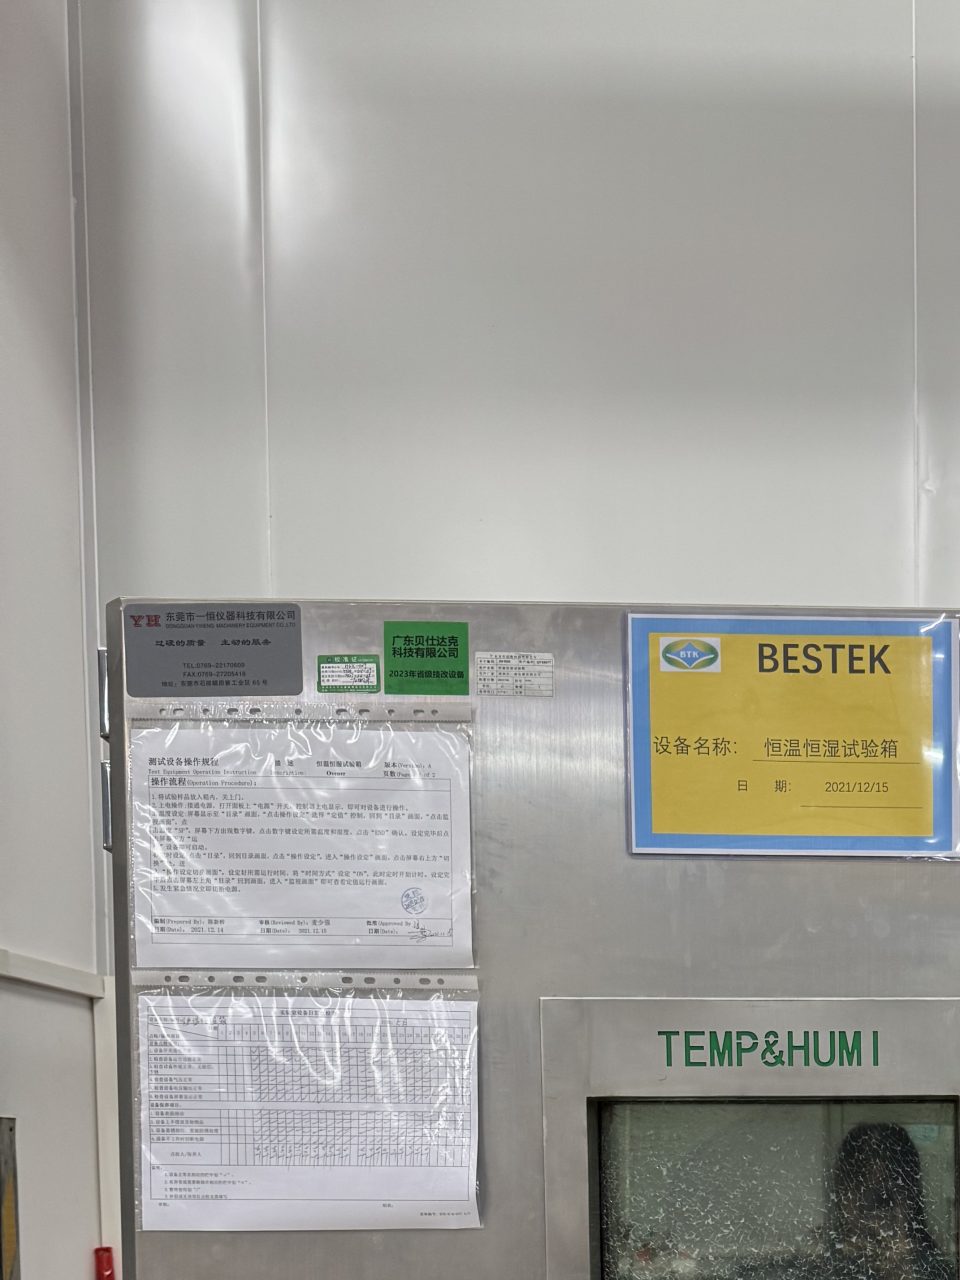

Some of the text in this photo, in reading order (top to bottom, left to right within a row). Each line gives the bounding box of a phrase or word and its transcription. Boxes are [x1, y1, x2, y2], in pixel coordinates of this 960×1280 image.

[166, 610, 296, 622] 东莞市一恒仪器科技有限公司
[392, 636, 459, 647] 广东贝仕达克
[392, 647, 459, 658] 科技有限公司
[758, 642, 892, 674] BESTEK
[389, 670, 465, 680] 2023年省级技改设备
[764, 738, 898, 759] 恒温恒湿试验箱
[825, 781, 889, 794] 2021/12/15
[658, 1030, 880, 1067] TEMP&HUMI
